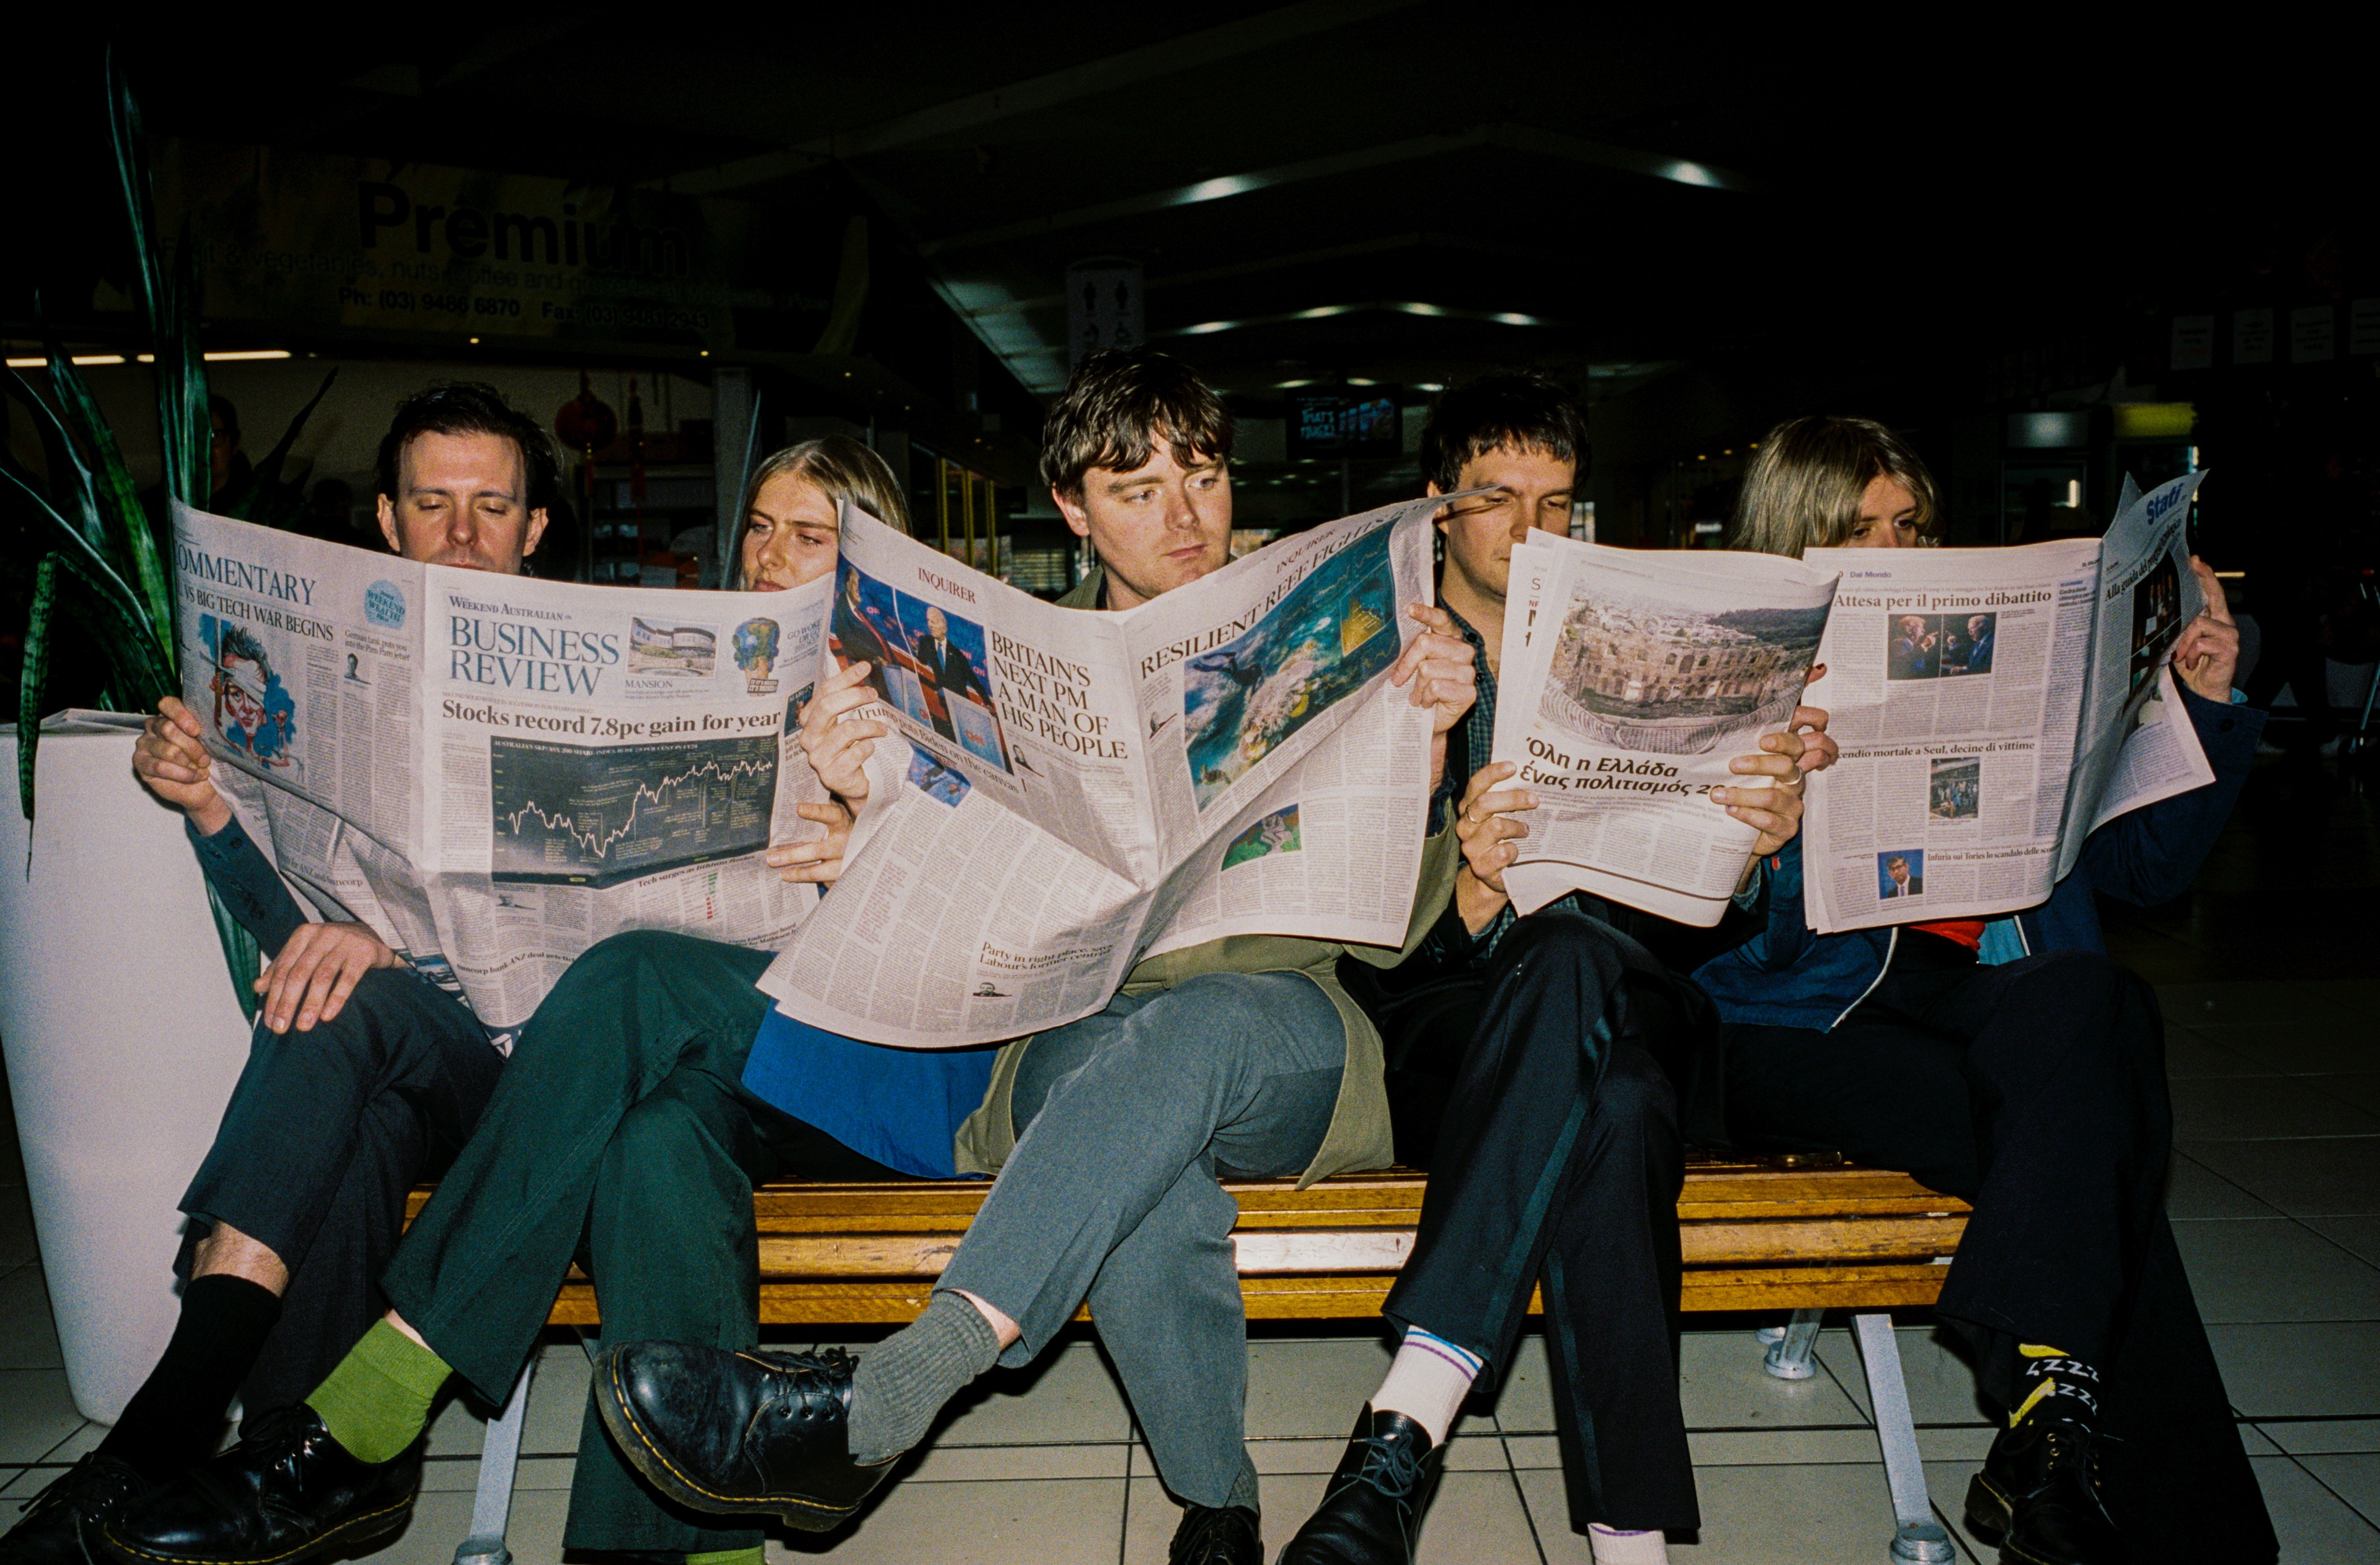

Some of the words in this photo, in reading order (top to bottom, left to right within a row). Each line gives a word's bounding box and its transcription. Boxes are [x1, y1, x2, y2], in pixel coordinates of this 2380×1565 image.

[358, 180, 688, 276] Premium
[339, 287, 371, 306] Ph:
[380, 291, 415, 312] (03)
[422, 293, 468, 313] 9486
[475, 296, 520, 316] 6870
[2146, 482, 2185, 526] Stati
[918, 567, 976, 604] INQUIRER
[2105, 583, 2120, 602] Alla
[2121, 569, 2139, 595] guida
[2139, 558, 2148, 577] del
[197, 590, 214, 609] BIG
[217, 596, 250, 619] TECH
[253, 605, 282, 628] WAR
[286, 615, 334, 642] BEGINS
[367, 589, 405, 615] WEEKEND
[449, 595, 499, 613] WEEKEND
[501, 603, 563, 621] AUSTRALIAN
[1834, 594, 1881, 607] Attesa
[1886, 596, 1912, 611] per
[1917, 593, 1927, 607] il
[1932, 594, 1981, 611] primo
[1985, 590, 2052, 605] dibattito
[449, 615, 620, 665] BUSINESS
[1141, 608, 1259, 681] RESILIENT
[1265, 563, 1310, 612] REEF
[450, 650, 605, 696] REVIEW
[991, 630, 1091, 687] BRITAIN'S
[625, 679, 673, 688] MANSION
[993, 655, 1047, 695] NEXT
[1053, 681, 1089, 710] PM
[442, 699, 510, 726] Stocks
[515, 712, 585, 734] record
[590, 717, 645, 739] 7.8pc
[650, 716, 696, 737] gain
[702, 713, 736, 731] for
[738, 710, 782, 734] year
[999, 682, 1012, 703] A
[1018, 689, 1067, 726] MAN
[1074, 712, 1109, 736] OF
[1002, 702, 1034, 732] HIS
[1039, 718, 1128, 759] PEOPLE
[1837, 749, 1871, 759] cendio
[1874, 747, 1912, 757] mortale
[1923, 745, 1948, 756] Seul,
[1950, 743, 1984, 753] decine
[1986, 742, 1996, 751] di
[1998, 741, 2035, 751] vittime
[919, 730, 948, 752] Biden
[965, 754, 981, 772] the
[1526, 737, 1570, 769] Όλη
[1576, 757, 1590, 771] η
[1597, 757, 1678, 778] Ελλάδα
[1520, 760, 1570, 790] ένας
[1575, 775, 1692, 796] πολιτισμός
[1927, 853, 1951, 862] Infuria
[1965, 852, 1985, 860] Tories
[1994, 849, 2023, 858] scandalo
[638, 876, 657, 887] Tech
[659, 870, 685, 880] surges
[457, 963, 489, 975] Suncorp
[979, 953, 1027, 970] Labour's
[1030, 957, 1070, 970] former
[1070, 949, 1111, 960] centrist
[983, 942, 1012, 961] Party
[1014, 954, 1025, 962] in
[1029, 954, 1055, 964] right
